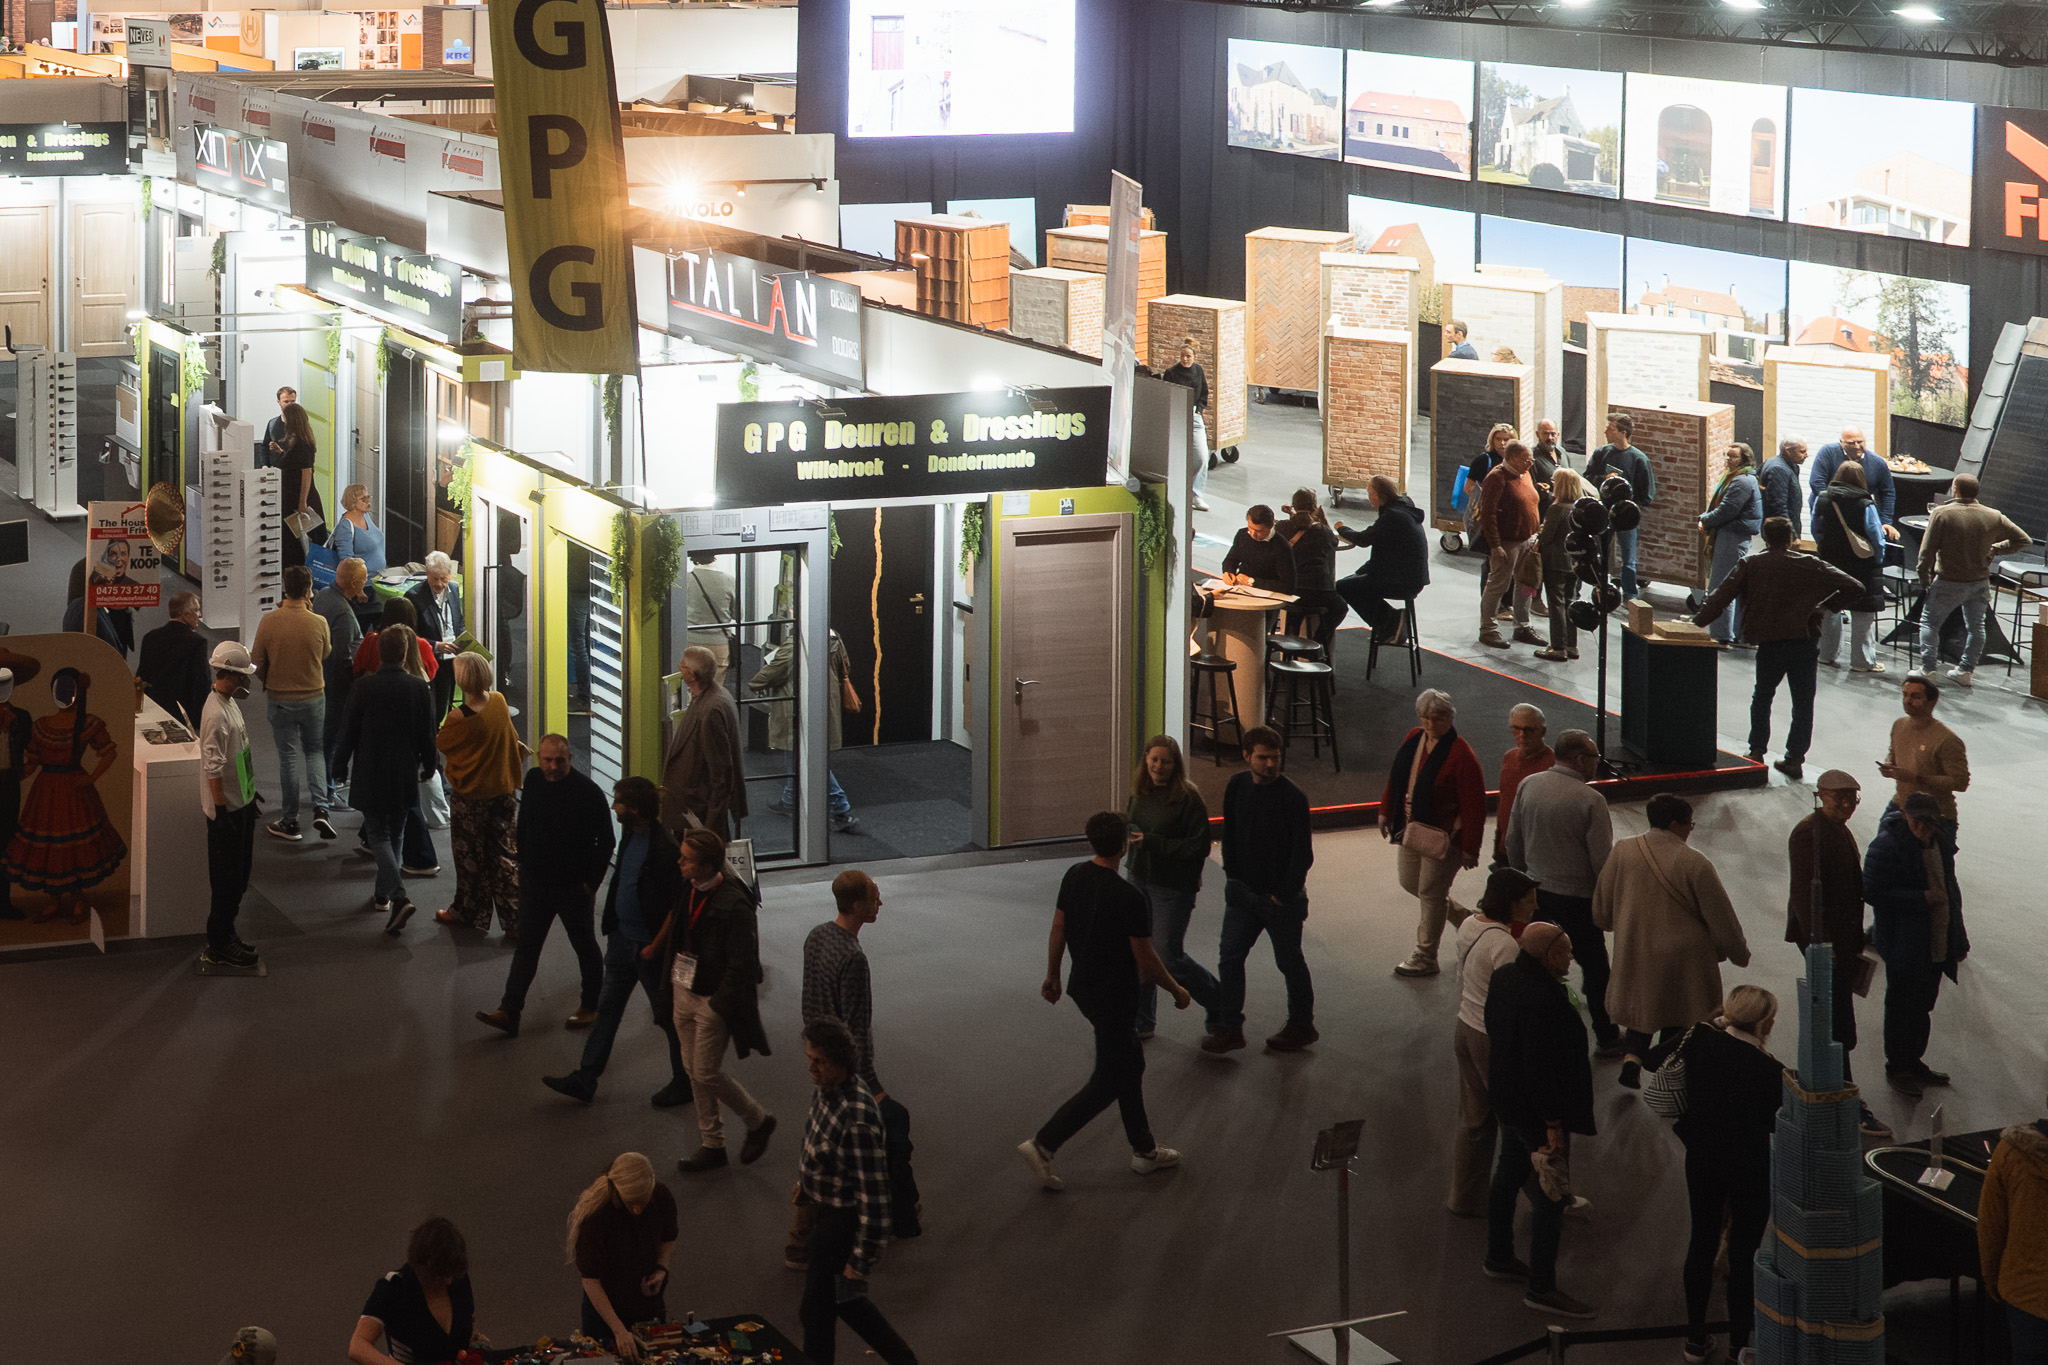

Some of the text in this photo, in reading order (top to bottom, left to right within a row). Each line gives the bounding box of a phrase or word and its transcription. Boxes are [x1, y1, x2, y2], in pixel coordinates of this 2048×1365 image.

[446, 52, 470, 60] KBC
[26, 134, 38, 147] &
[668, 251, 818, 340] ITALIAN
[830, 288, 858, 313] DESIGN
[832, 336, 859, 361] DOORS
[744, 411, 1086, 454] GPG Deuren & Dressings
[797, 457, 884, 480] Willebroek
[928, 450, 1036, 472] Dendermonde
[139, 546, 153, 557] TE
[130, 558, 160, 569] KOOP
[96, 585, 158, 595] 0475 73 27 40
